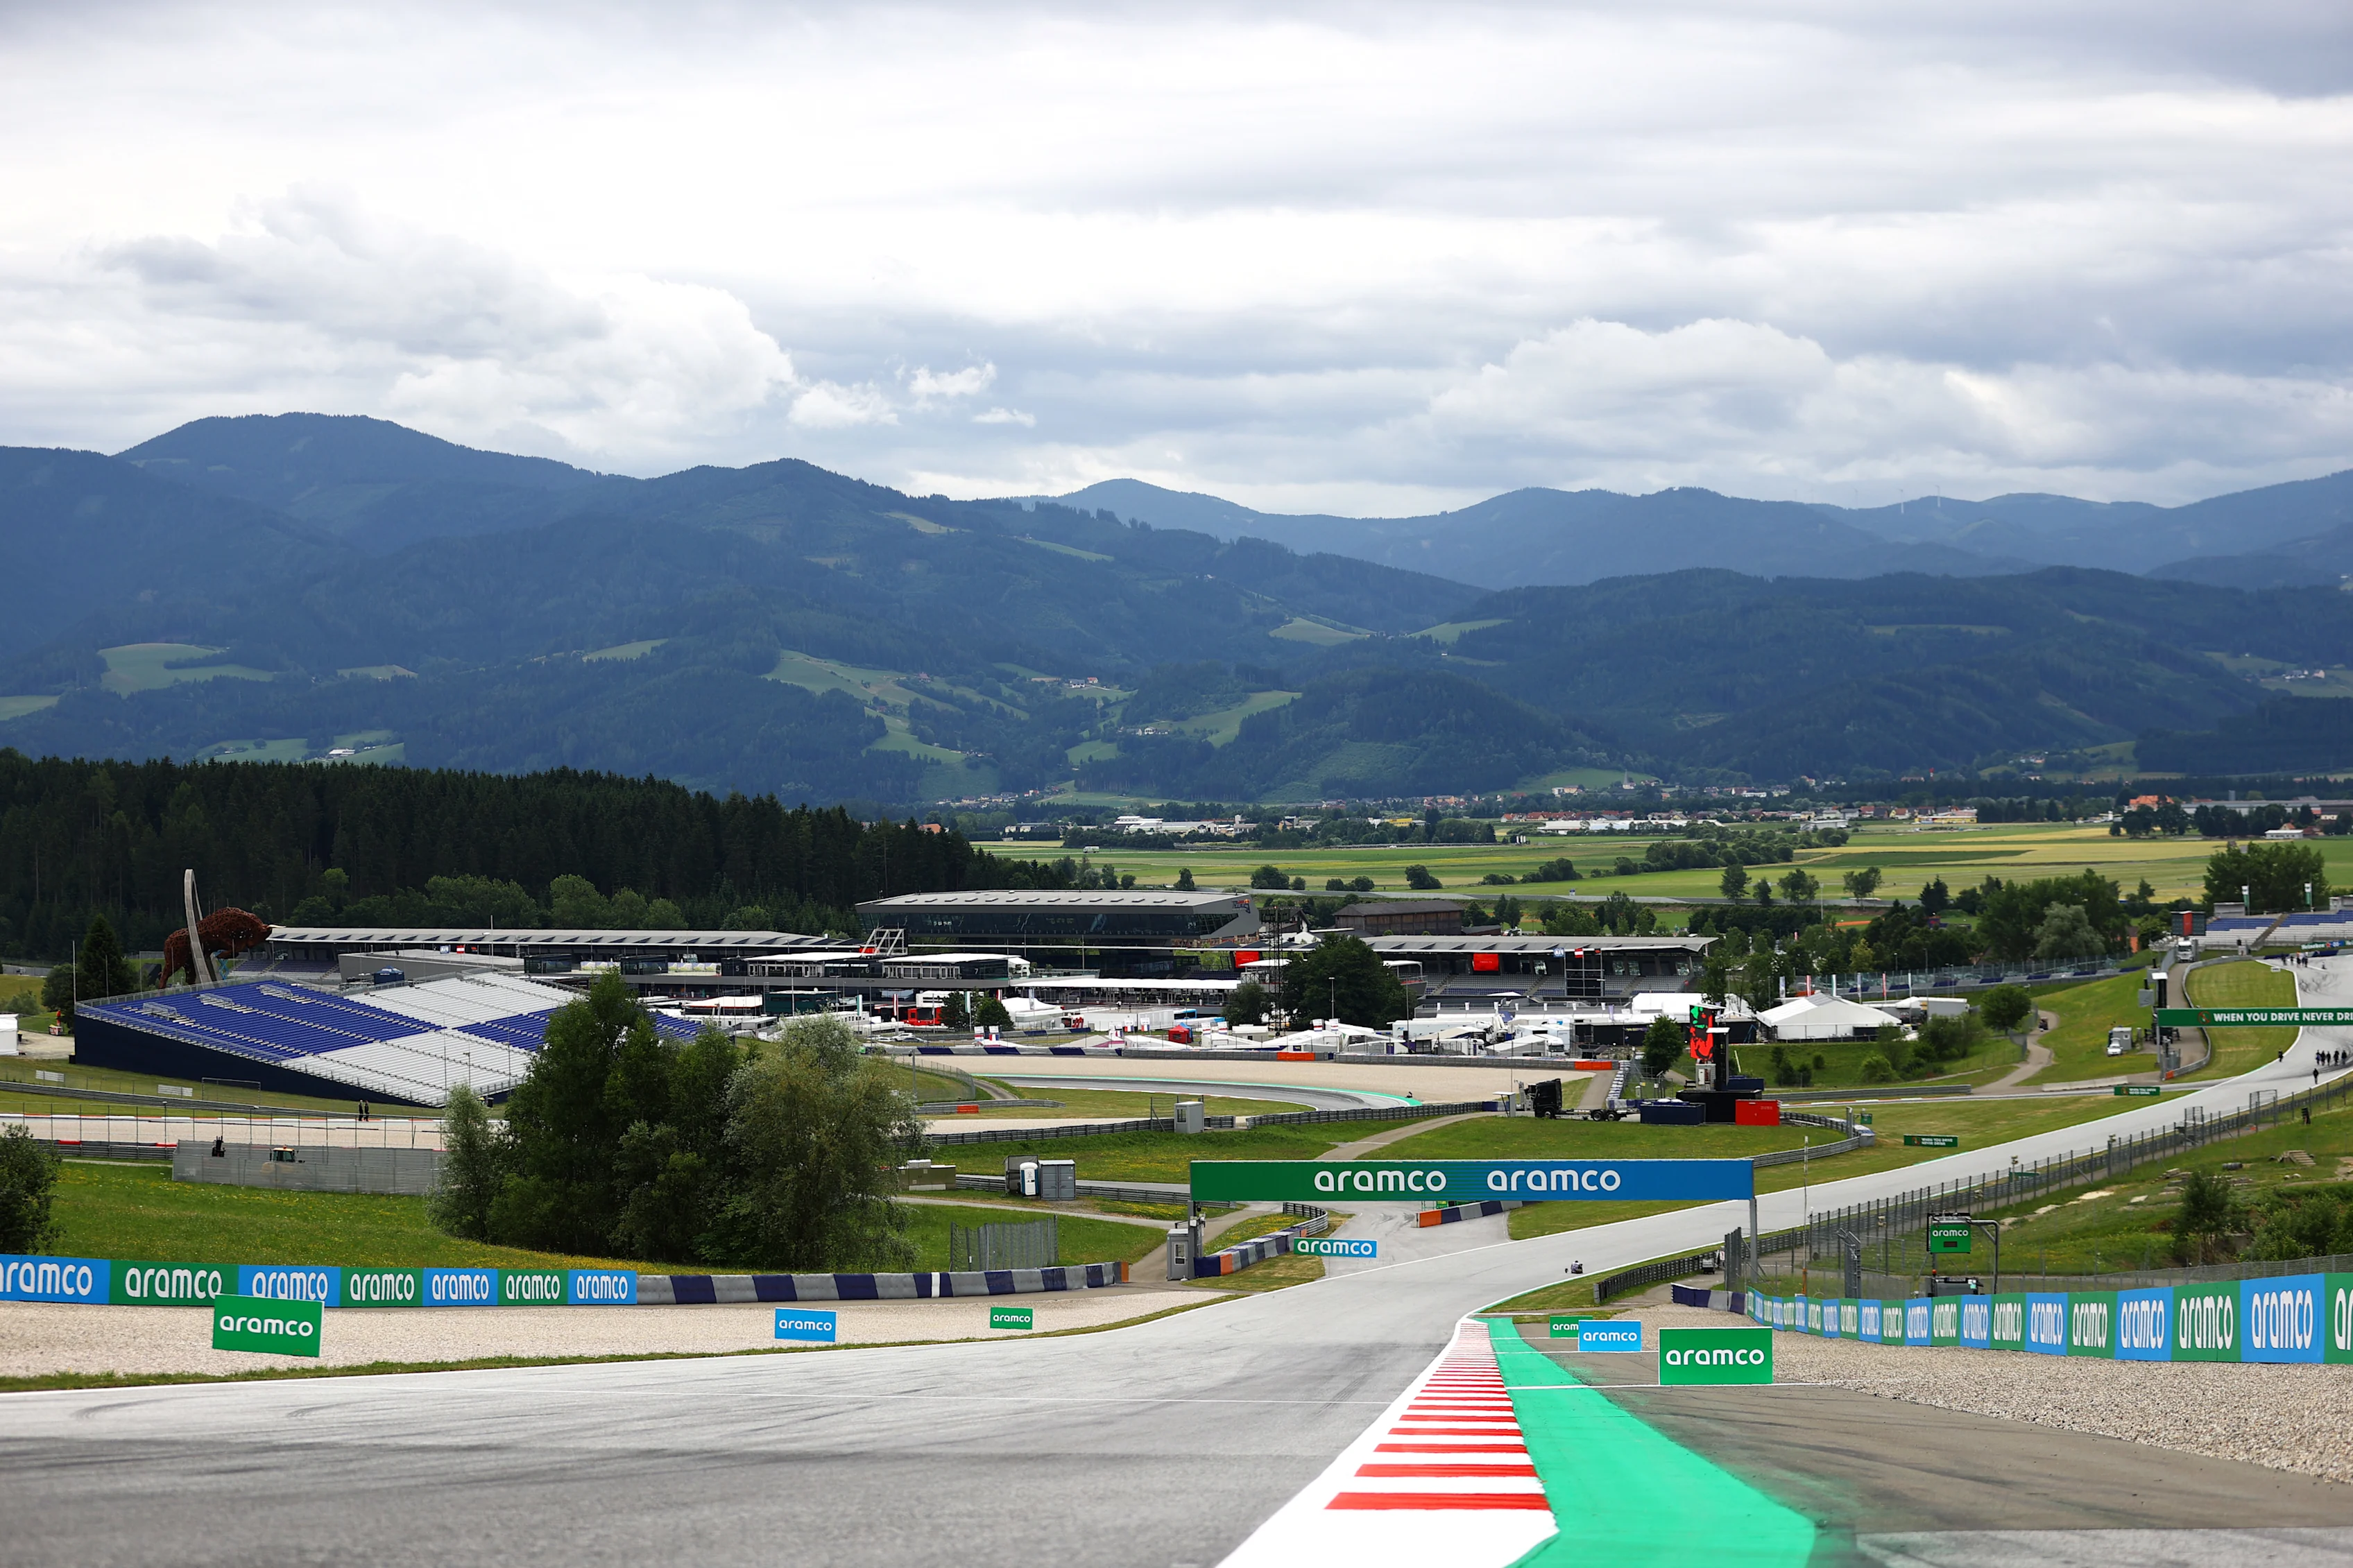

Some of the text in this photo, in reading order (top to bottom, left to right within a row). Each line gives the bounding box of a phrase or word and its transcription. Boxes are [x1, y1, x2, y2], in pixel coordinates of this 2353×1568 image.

[2214, 1013, 2243, 1022] WHEN
[2246, 1013, 2267, 1022] YOU
[2270, 1013, 2299, 1021] DRIVE
[2302, 1013, 2334, 1021] NEVER
[1315, 1169, 1621, 1191] aramco aramco
[1298, 1240, 1372, 1255] aramco
[125, 1267, 223, 1299] aramco
[253, 1272, 328, 1300] aramco
[350, 1273, 415, 1301] aramco
[431, 1275, 489, 1300] aramco
[506, 1275, 561, 1300] aramco
[576, 1275, 628, 1300] aramco
[219, 1315, 314, 1337] aramco
[778, 1318, 832, 1332] aramco
[993, 1313, 1031, 1323] aramco
[1963, 1304, 1988, 1341] aramco
[1994, 1302, 2022, 1341] aramco
[2030, 1302, 2063, 1345] aramco
[2073, 1302, 2109, 1348] aramco
[2121, 1300, 2165, 1350] aramco
[2179, 1295, 2234, 1350] aramco
[2251, 1289, 2313, 1350] aramco
[1583, 1330, 1638, 1342] aramco
[1666, 1348, 1765, 1365] aramco
